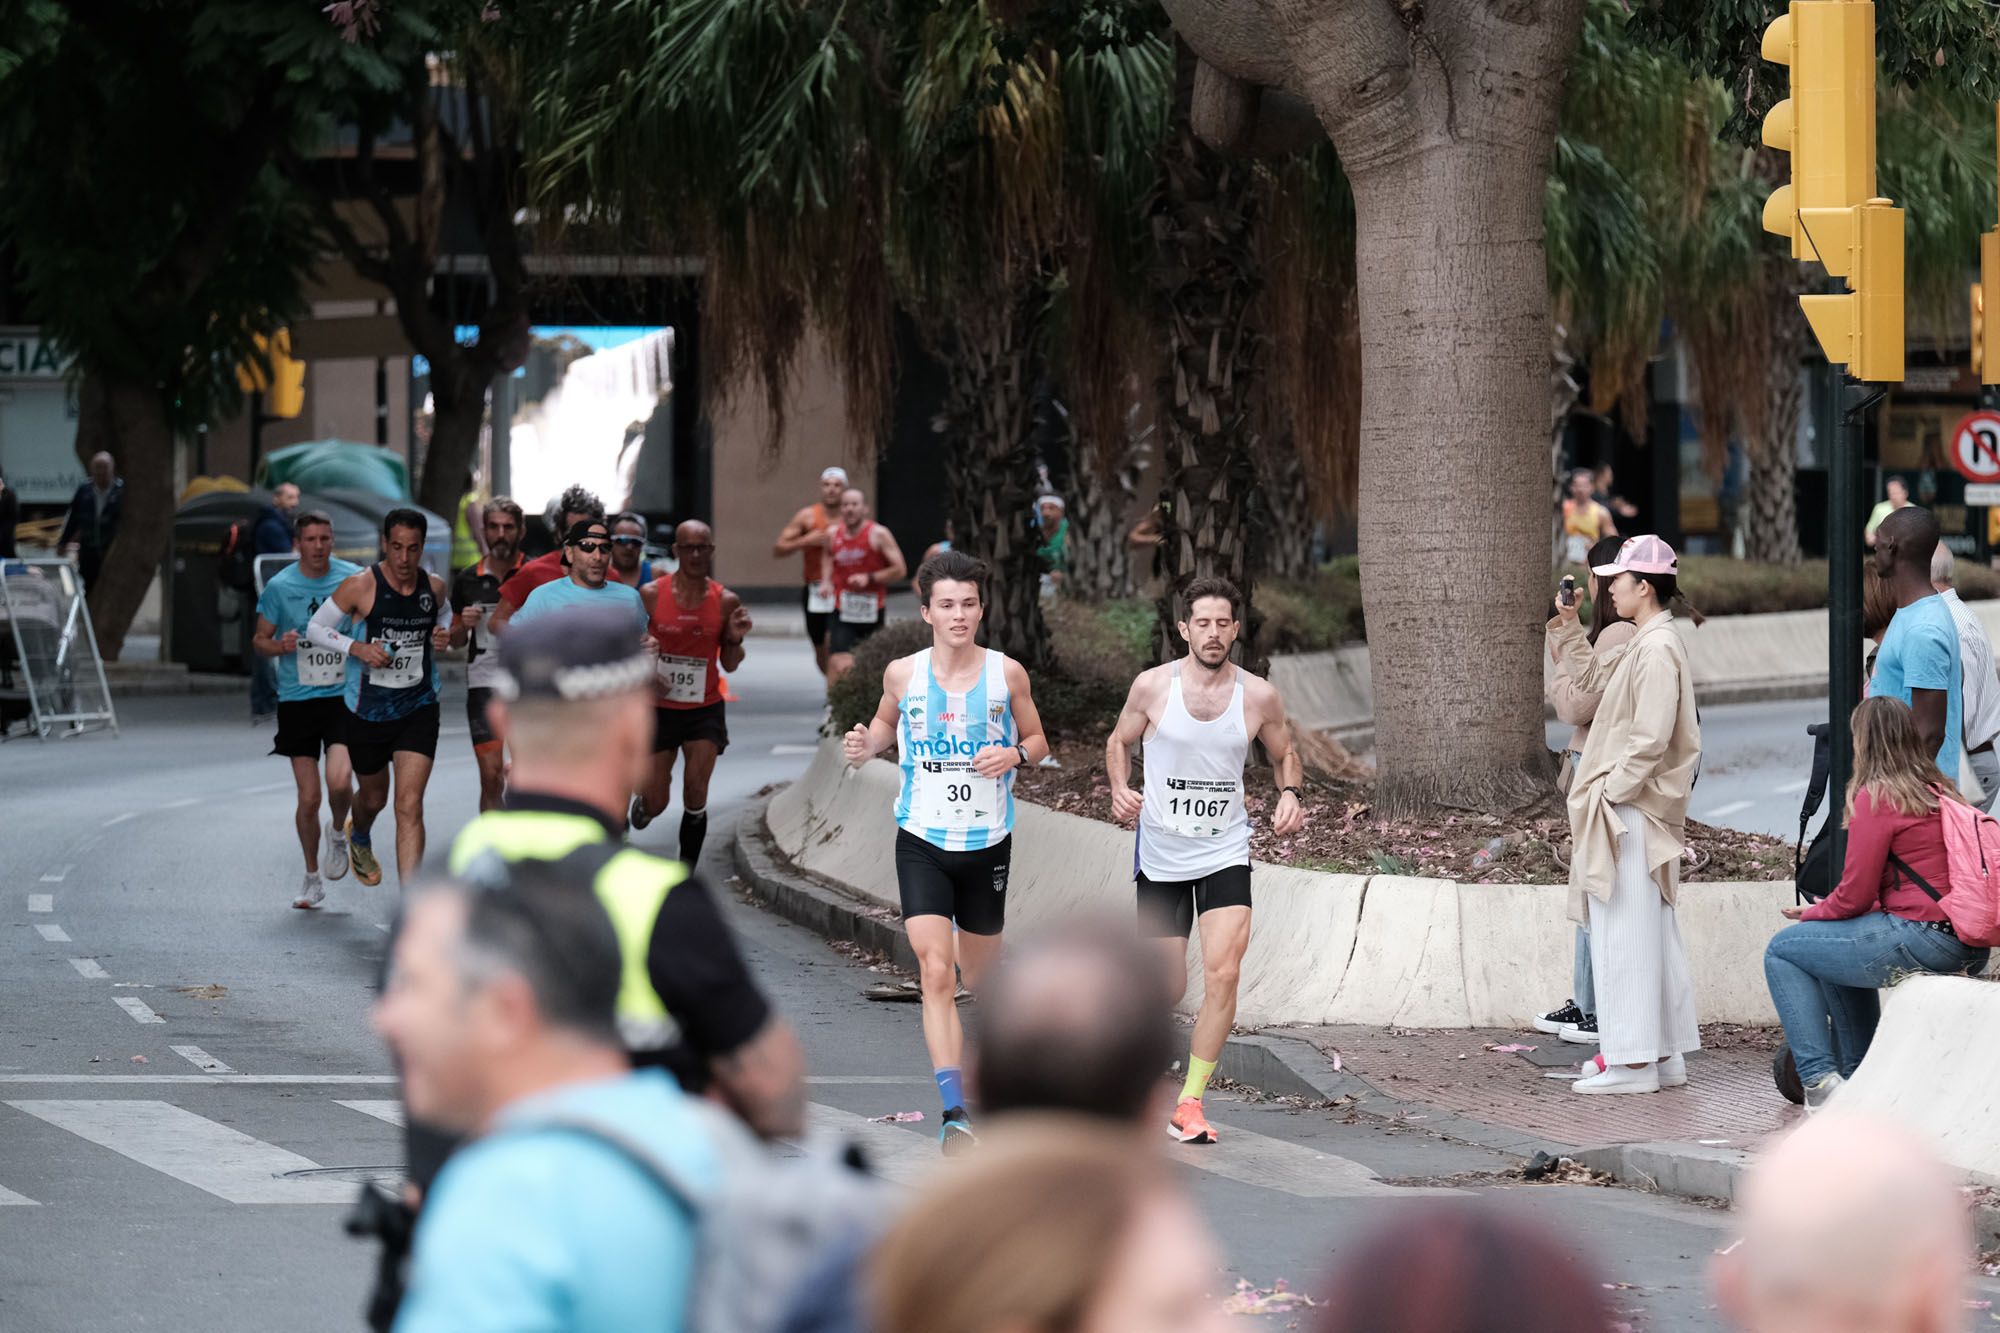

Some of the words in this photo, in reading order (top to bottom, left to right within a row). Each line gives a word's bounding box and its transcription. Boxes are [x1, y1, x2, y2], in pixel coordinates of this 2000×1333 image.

[307, 652, 342, 666] 1009
[669, 672, 694, 685] 195
[922, 761, 942, 773] 43
[1166, 777, 1186, 790] 43
[947, 784, 972, 802] 30
[1169, 797, 1230, 817] 11067
